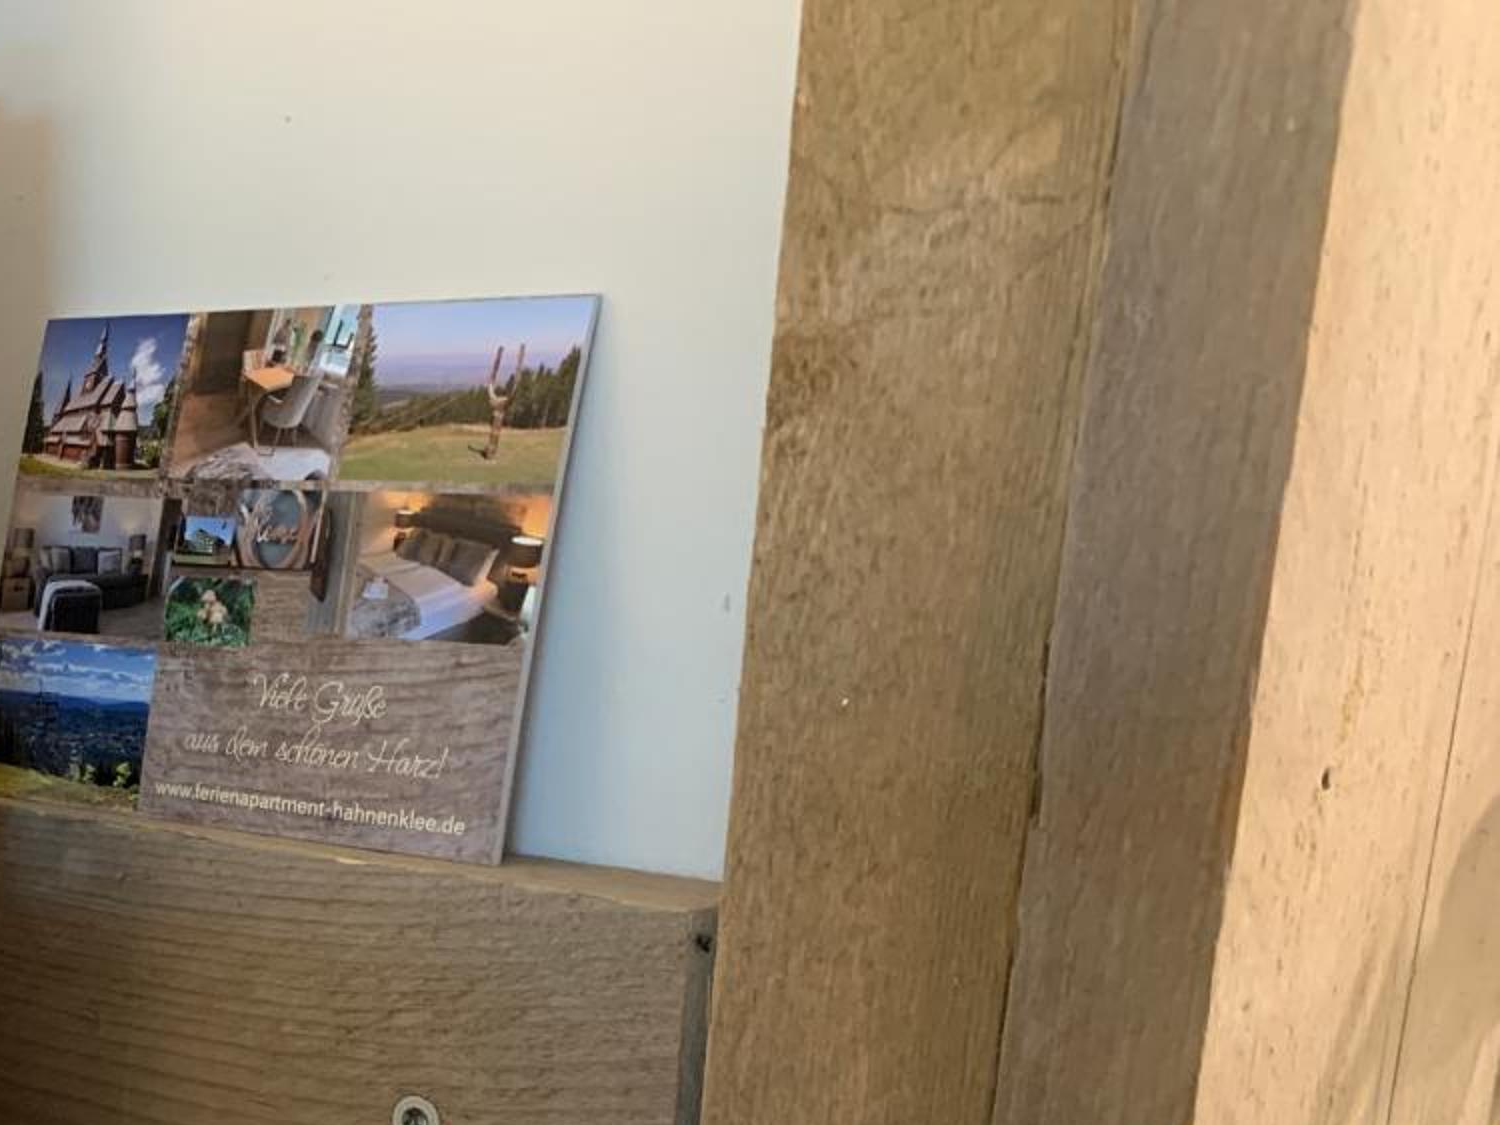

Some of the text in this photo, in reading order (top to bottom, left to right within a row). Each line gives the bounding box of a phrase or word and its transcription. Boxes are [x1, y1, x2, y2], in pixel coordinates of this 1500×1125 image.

[184, 732, 220, 753] aus
[225, 725, 269, 762] dem
[367, 737, 450, 779] Harz!
[155, 780, 466, 836] www.ferienapartment-hahnenklee.de
